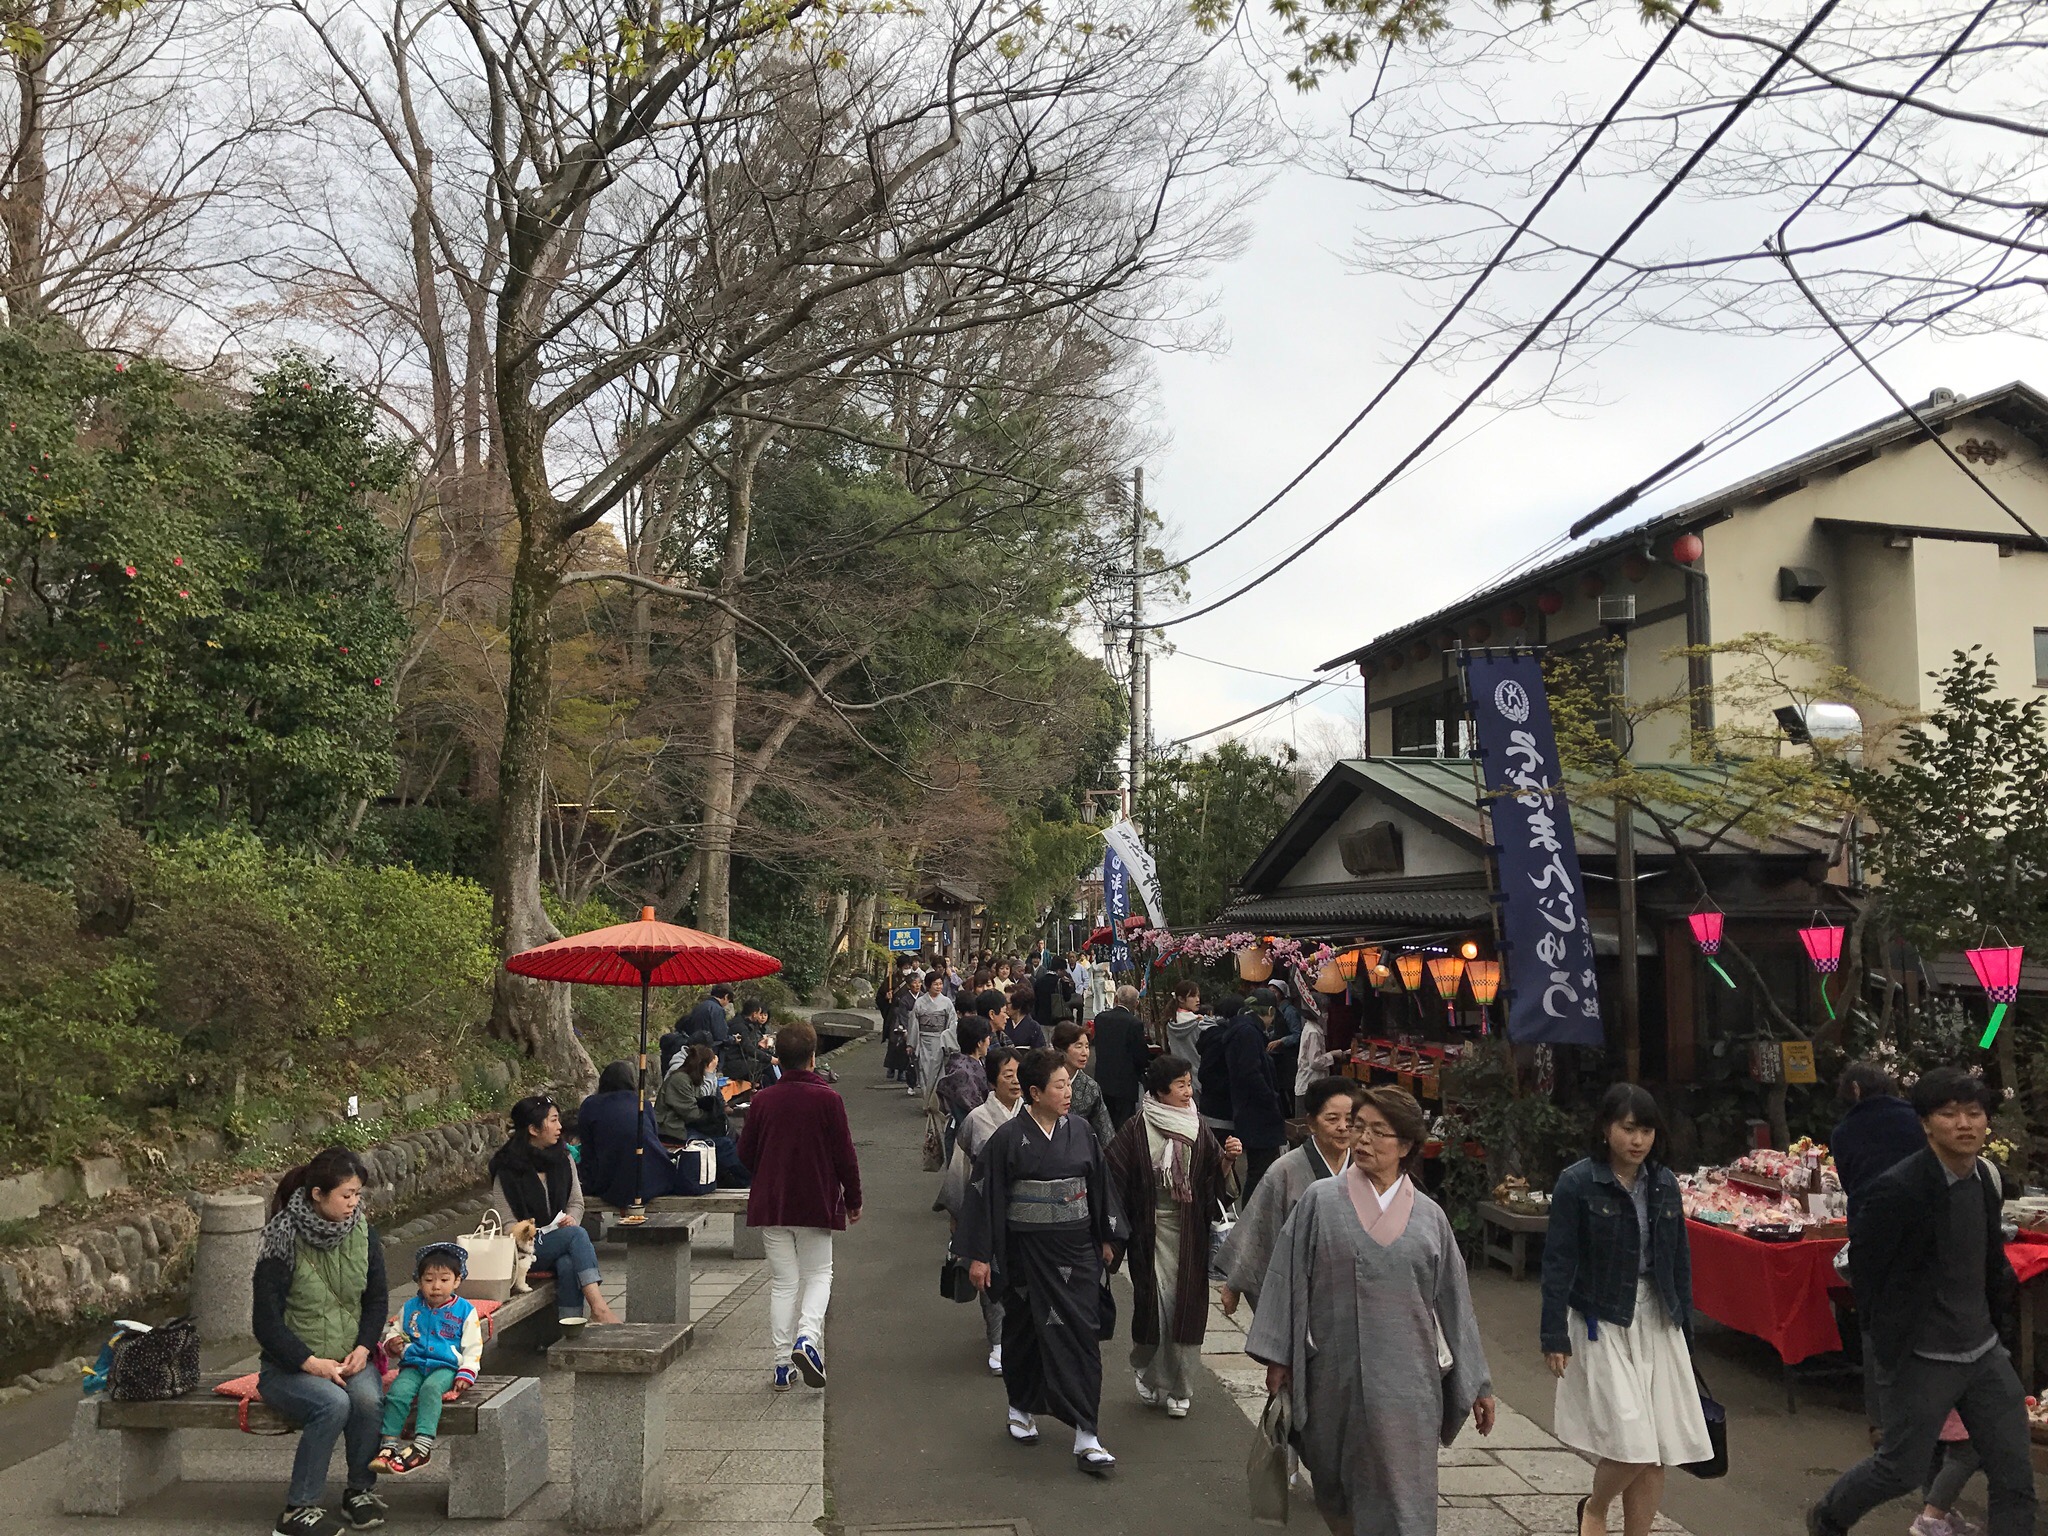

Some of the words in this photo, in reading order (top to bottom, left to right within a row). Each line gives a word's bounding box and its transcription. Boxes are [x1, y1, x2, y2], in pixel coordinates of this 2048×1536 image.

[896, 931, 911, 939] 東京
[893, 938, 915, 946] きもの
